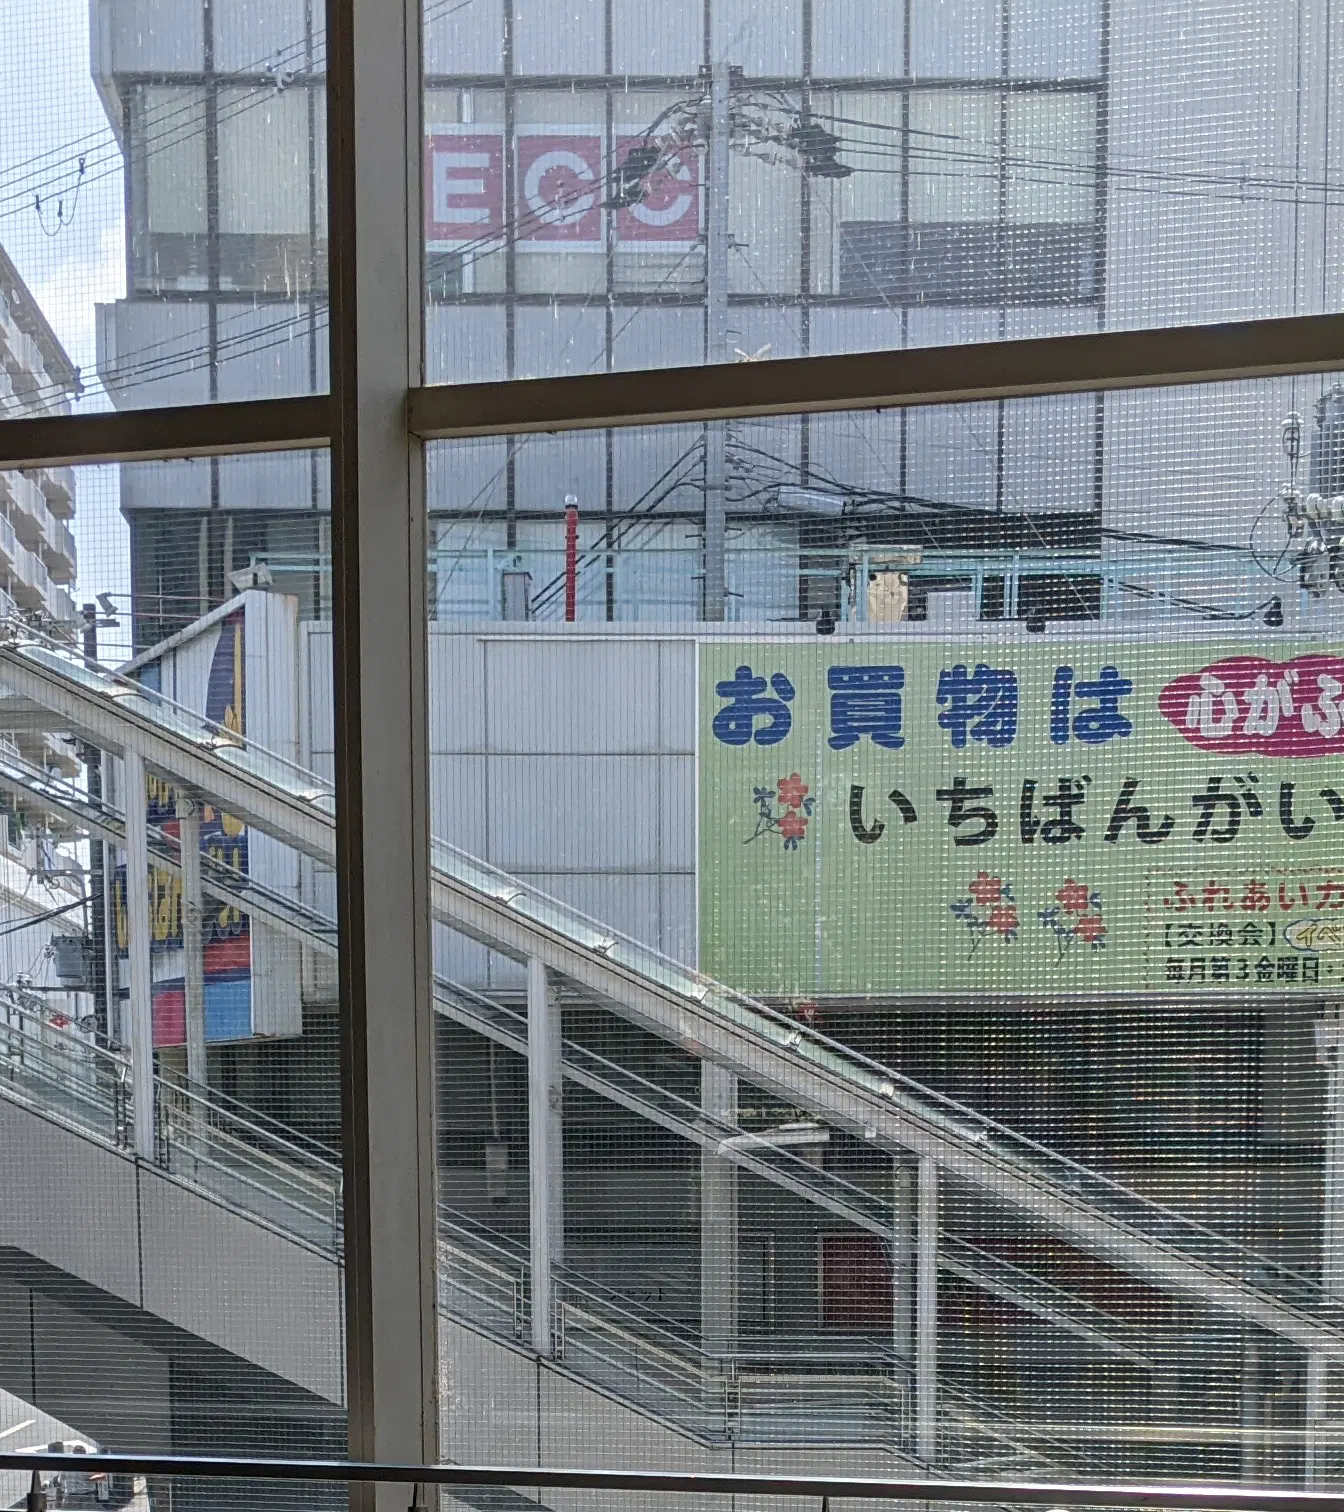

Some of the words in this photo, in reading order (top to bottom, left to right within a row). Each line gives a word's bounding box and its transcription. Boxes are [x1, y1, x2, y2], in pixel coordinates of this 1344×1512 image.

[432, 150, 692, 226] ECC
[712, 664, 1134, 750] お買物は
[1164, 921, 1277, 948] 【交換会】
